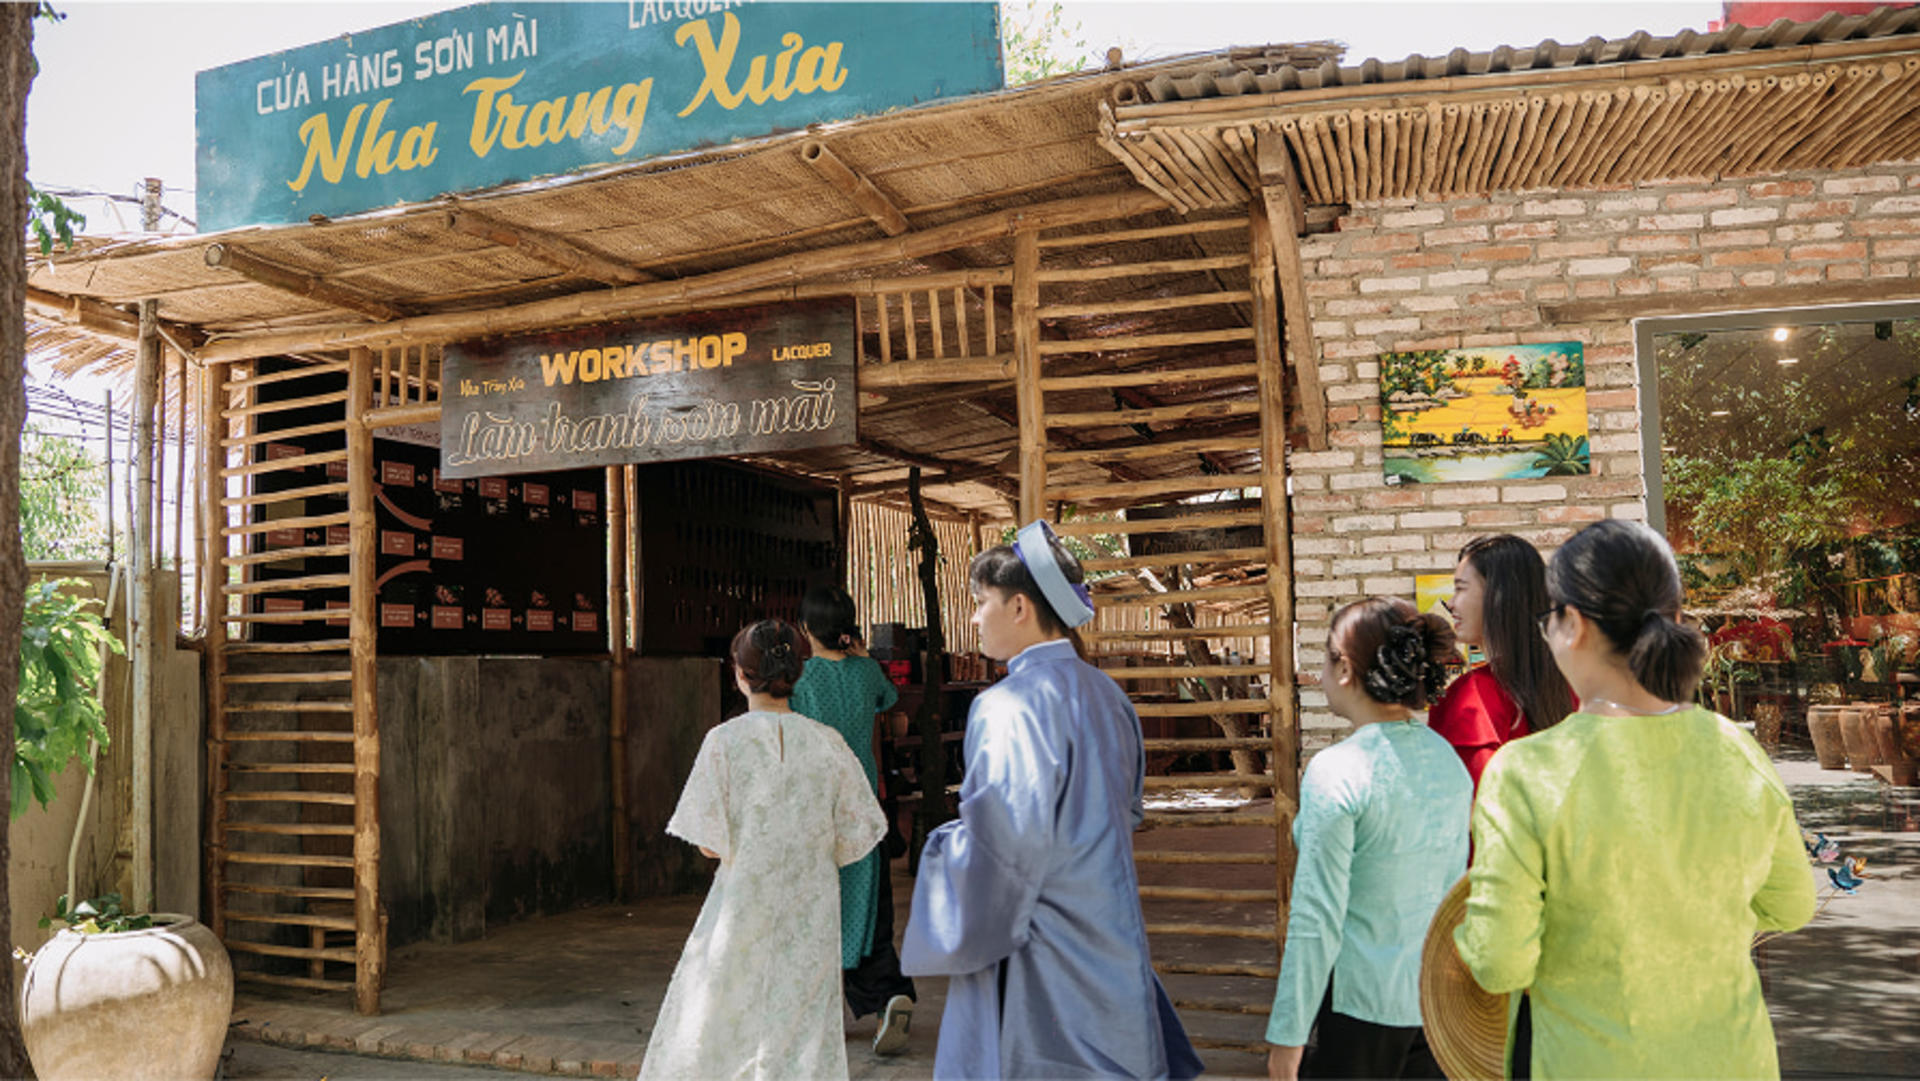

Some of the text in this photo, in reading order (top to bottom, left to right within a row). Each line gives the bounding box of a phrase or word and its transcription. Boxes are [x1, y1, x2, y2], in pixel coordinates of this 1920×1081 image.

[257, 12, 537, 115] CỬA HÀNG SƠN MÀI
[287, 98, 439, 192] Nha
[462, 68, 654, 159] Trang
[540, 332, 747, 387] WORKSHOP
[772, 342, 832, 362] LACQUER
[448, 377, 837, 466] Làm tranh sơn mài
